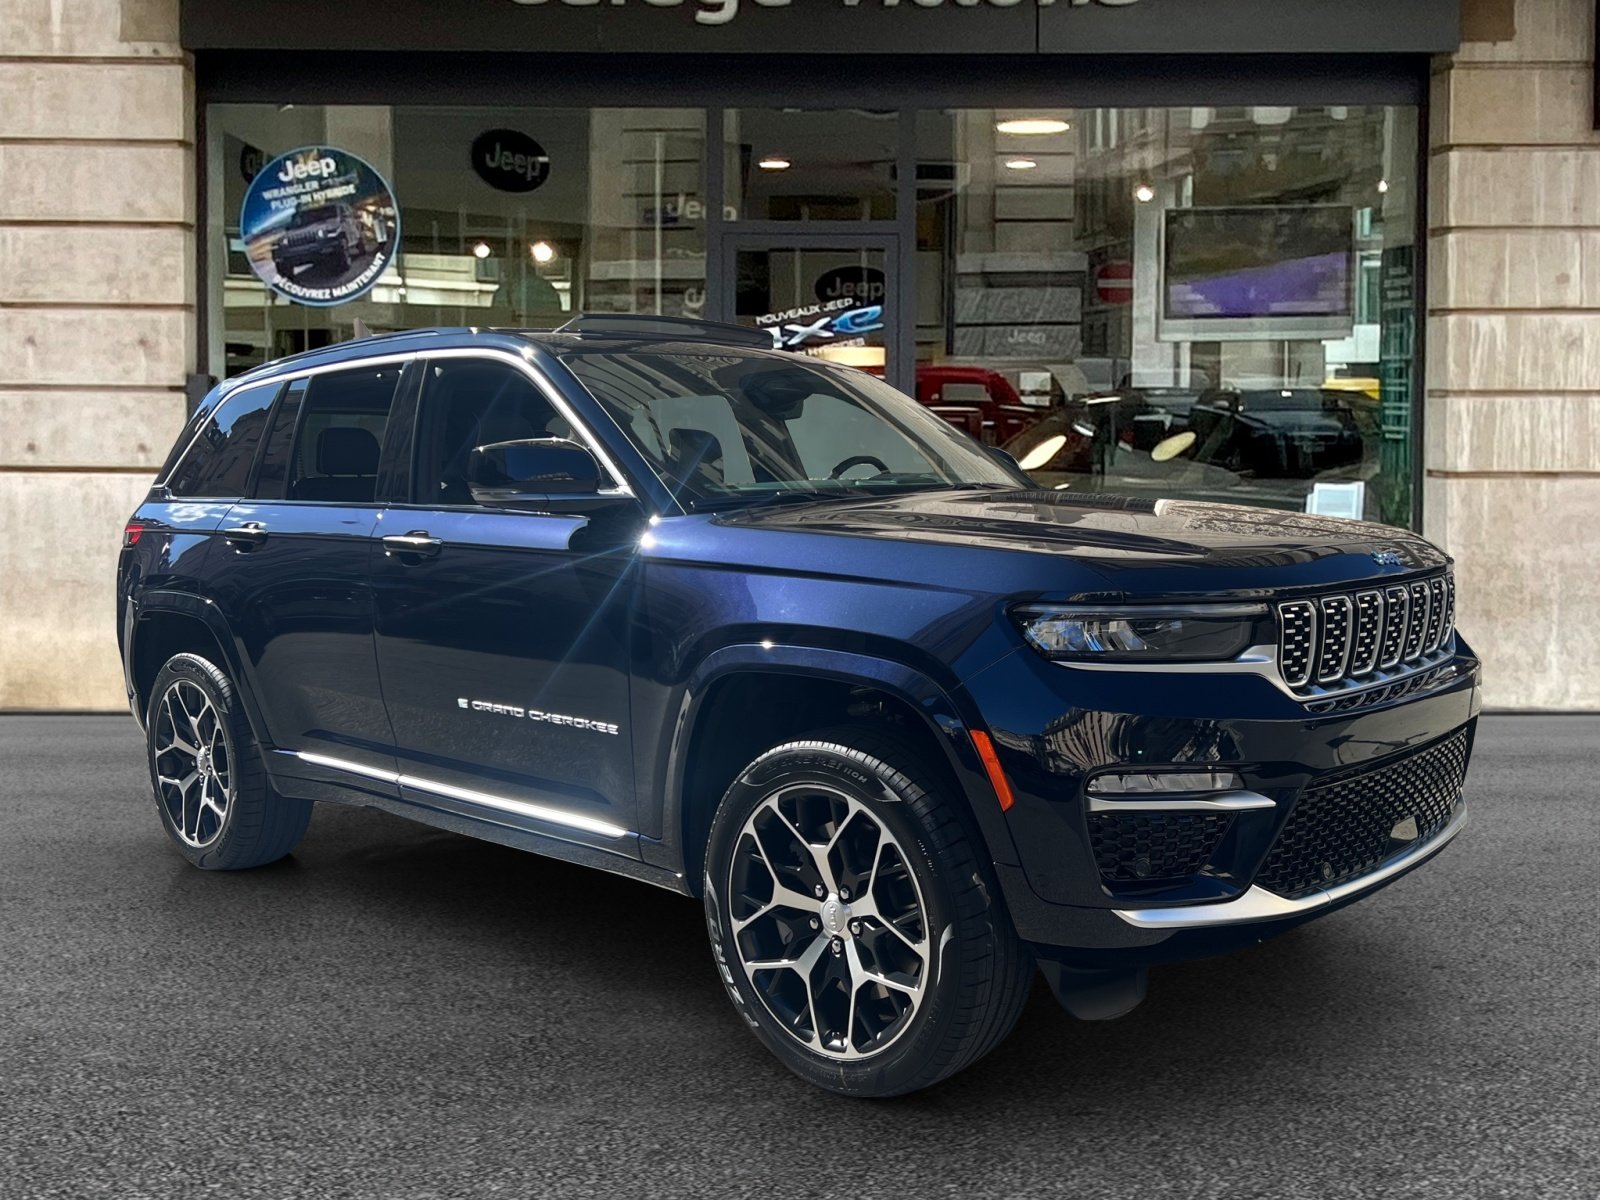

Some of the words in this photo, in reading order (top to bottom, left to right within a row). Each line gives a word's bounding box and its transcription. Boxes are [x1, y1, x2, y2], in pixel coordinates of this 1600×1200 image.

[278, 157, 337, 182] Jeep
[485, 142, 541, 180] Jeep
[262, 180, 320, 201] WRANGLER
[332, 252, 386, 298] MAINTENANT
[827, 276, 884, 301] Jeep
[756, 304, 820, 326] NOUVEAUX
[823, 297, 854, 312] JEEP
[471, 700, 525, 718] GRAND
[528, 710, 619, 735] CHEROKEE
